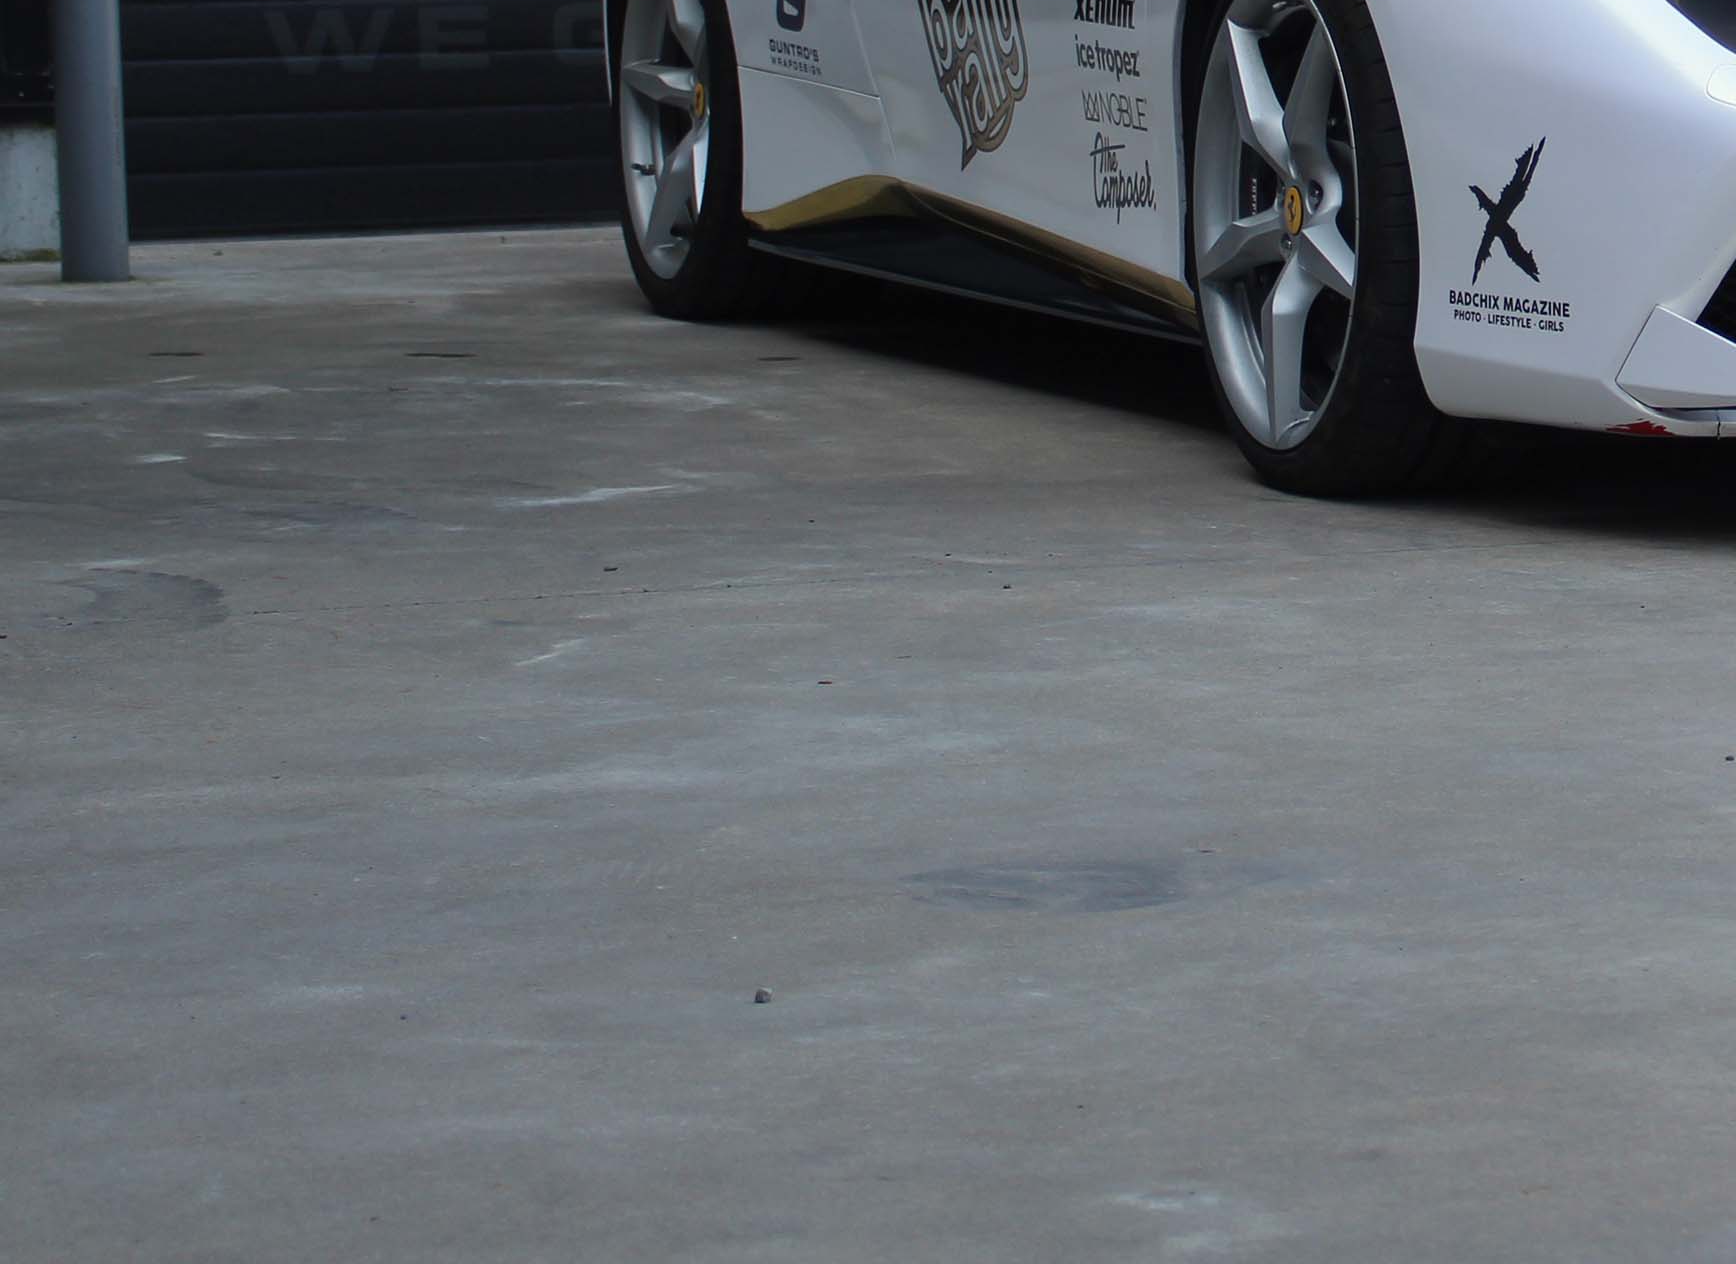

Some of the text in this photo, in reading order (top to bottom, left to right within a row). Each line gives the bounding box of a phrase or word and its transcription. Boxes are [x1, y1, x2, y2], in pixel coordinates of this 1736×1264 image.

[263, 3, 491, 77] WE
[1099, 90, 1148, 132] NOBLE
[1449, 289, 1571, 318] BADCHIX MAGAZINE
[1453, 309, 1565, 333] PHOTO LIFESTYLE GIRLS
